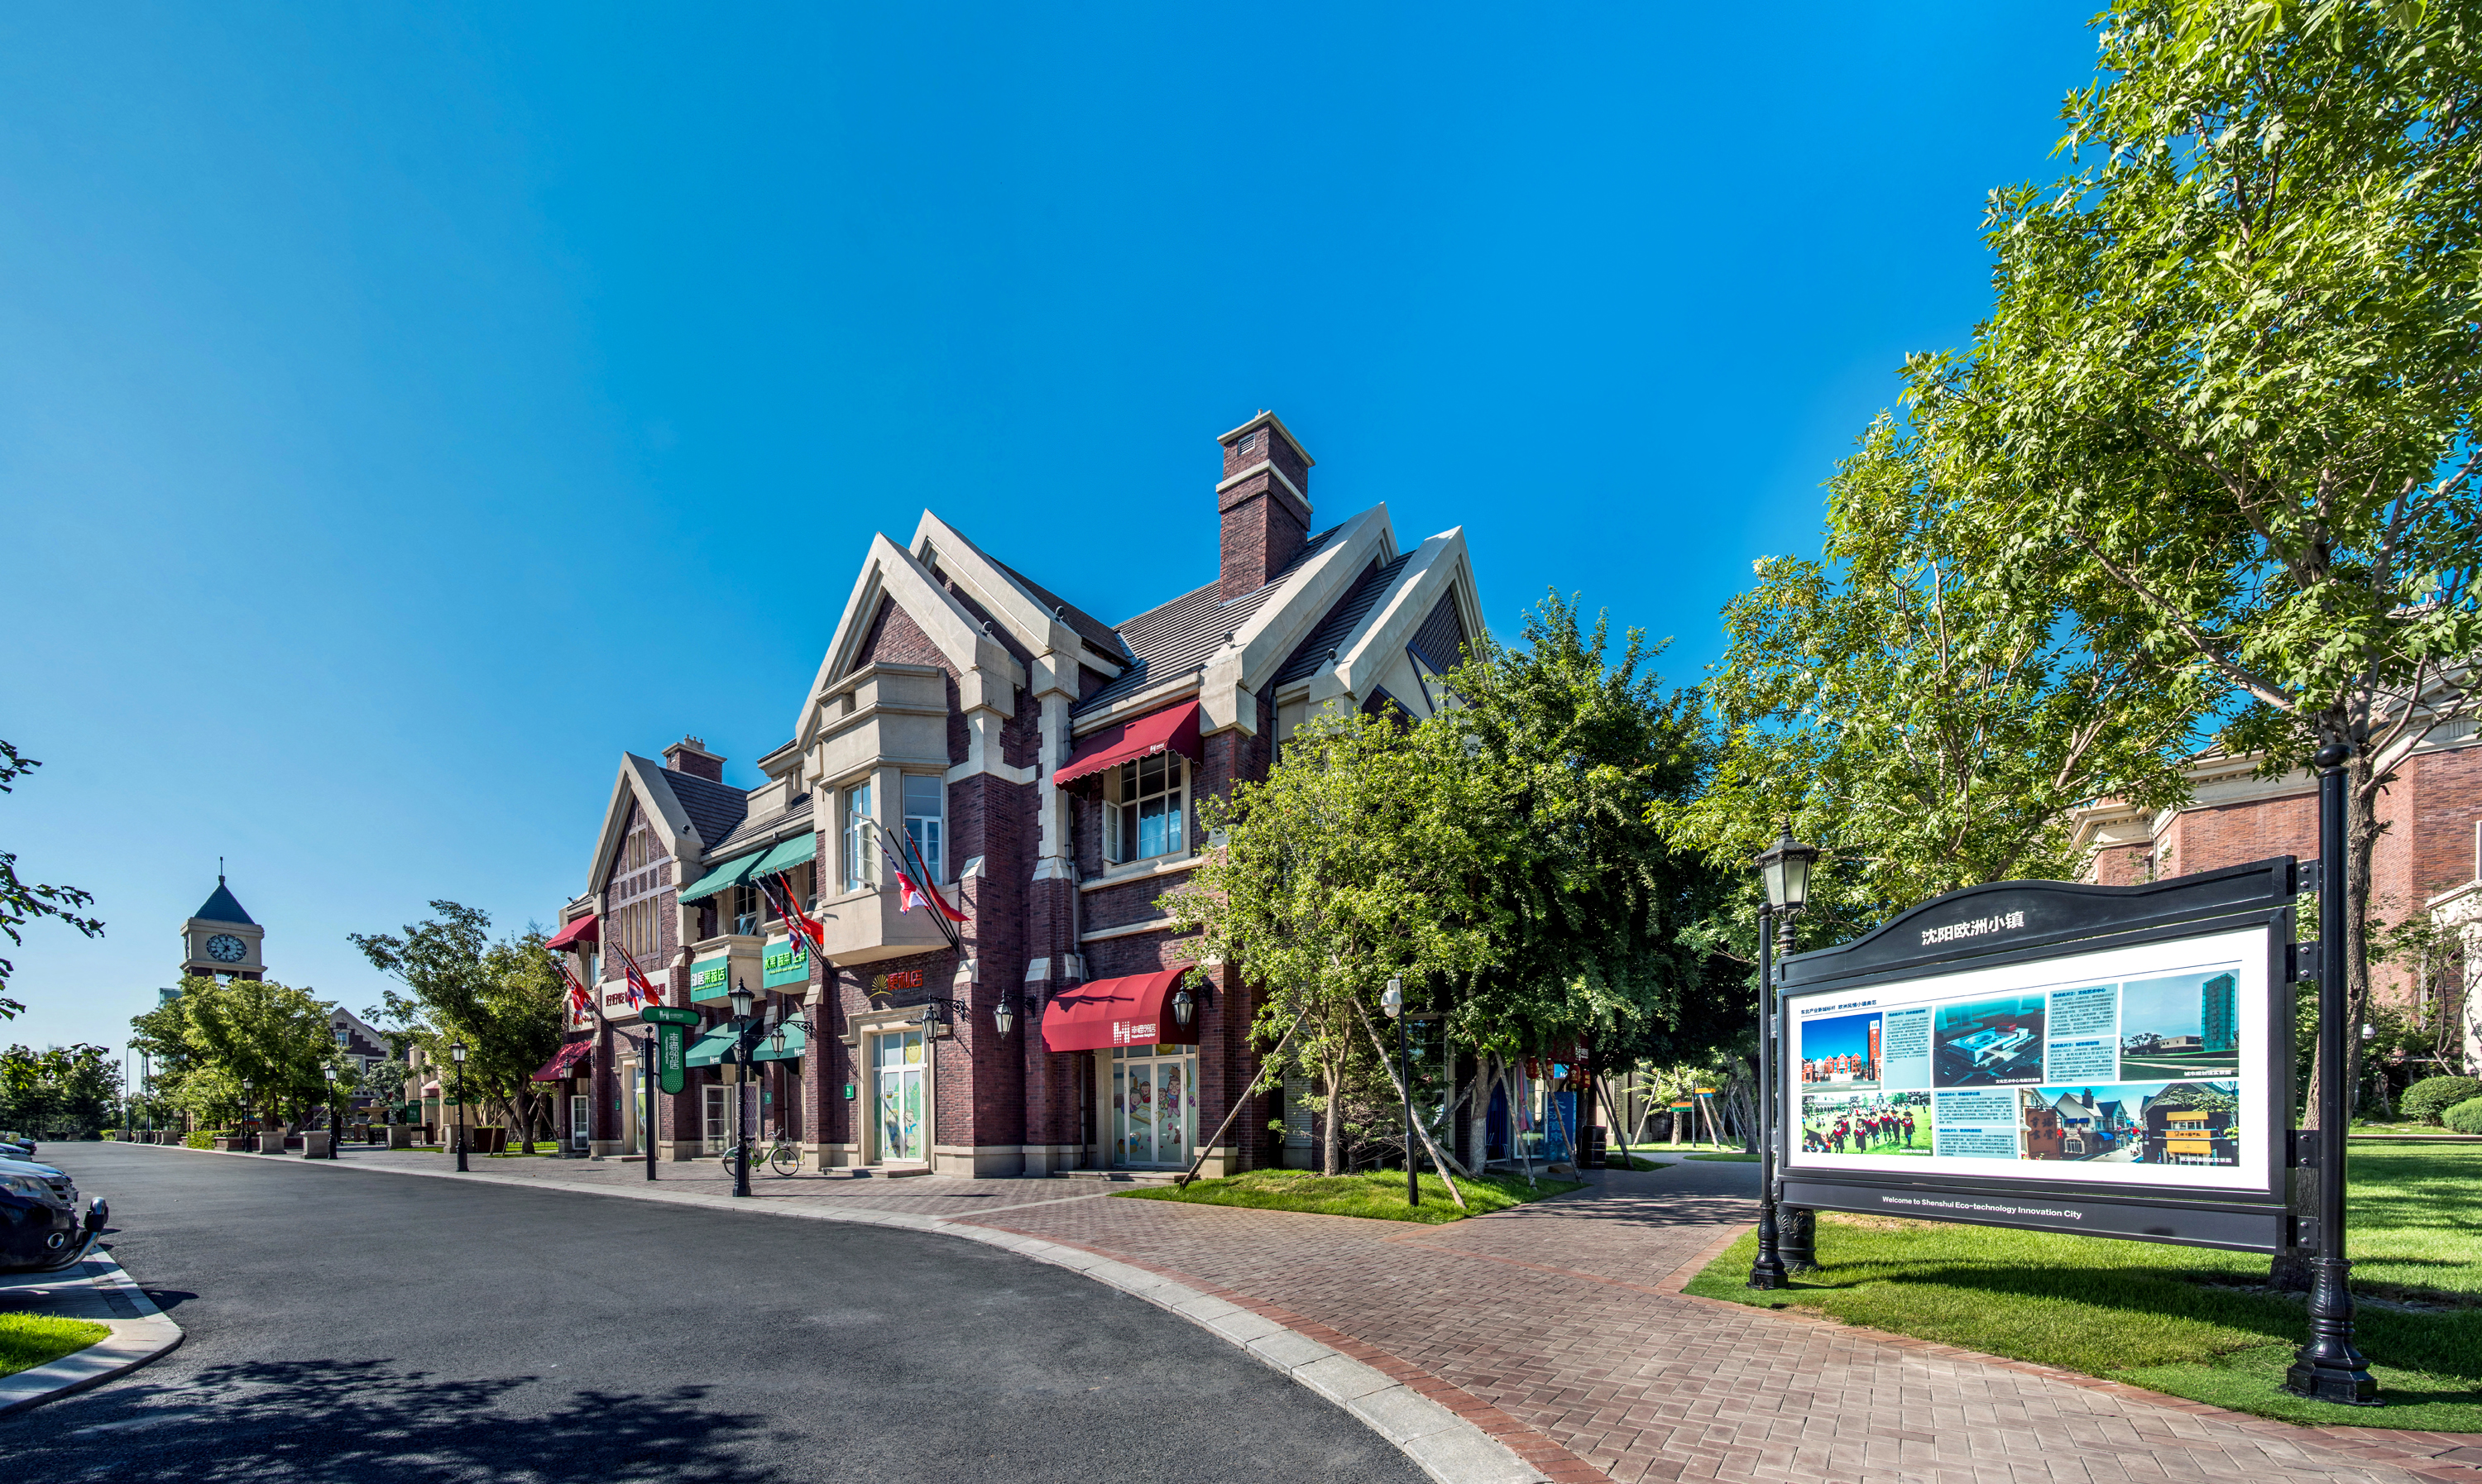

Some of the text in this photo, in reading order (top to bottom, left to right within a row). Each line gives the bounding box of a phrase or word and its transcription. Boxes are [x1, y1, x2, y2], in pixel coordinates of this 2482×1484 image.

[1921, 911, 2024, 945] 沈阳欧洲小镇
[764, 955, 777, 969] 水果
[778, 952, 791, 966] 蔬菜
[691, 967, 725, 988] 邻居果蔬店
[887, 969, 922, 991] 便利店
[1801, 999, 1877, 1014] 东北产业新城标杆 欧洲风情小镇典范
[1882, 1196, 1912, 1204] Welcome
[1922, 1199, 1954, 1208] Shenshui
[1955, 1202, 2016, 1214] Eco-technology
[2018, 1206, 2063, 1217] Innovation
[2063, 1210, 2082, 1219] City
